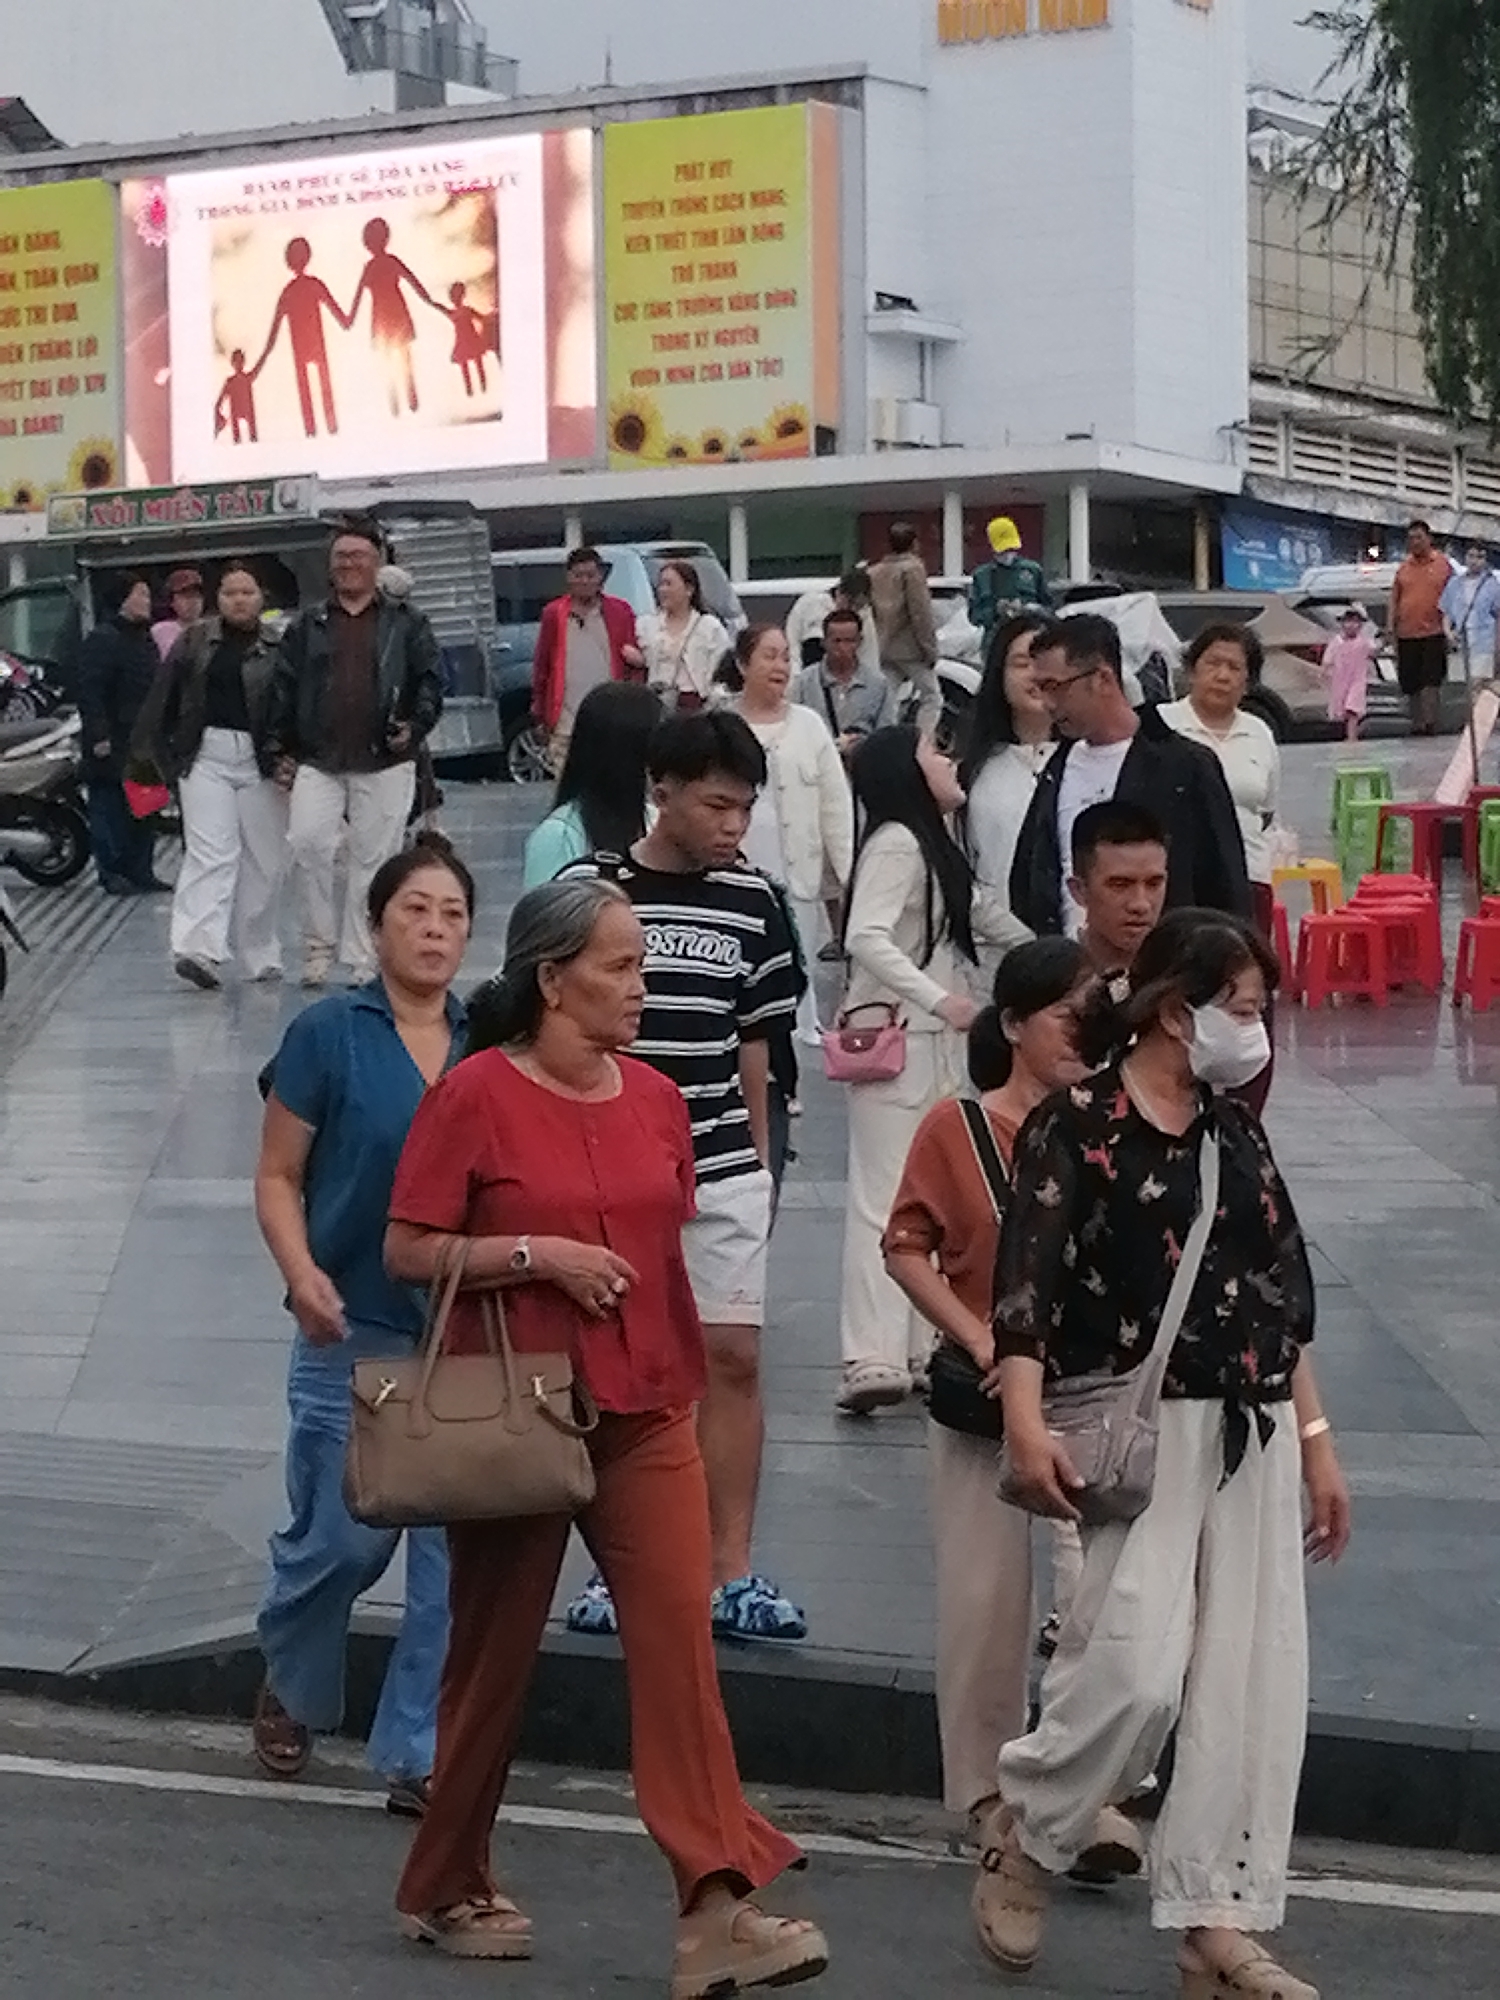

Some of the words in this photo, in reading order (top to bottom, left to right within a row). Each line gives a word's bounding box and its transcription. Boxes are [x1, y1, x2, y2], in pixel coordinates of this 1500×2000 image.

[90, 495, 138, 527] XÔI
[142, 487, 208, 523] MIỀN
[214, 484, 270, 518] TÂY
